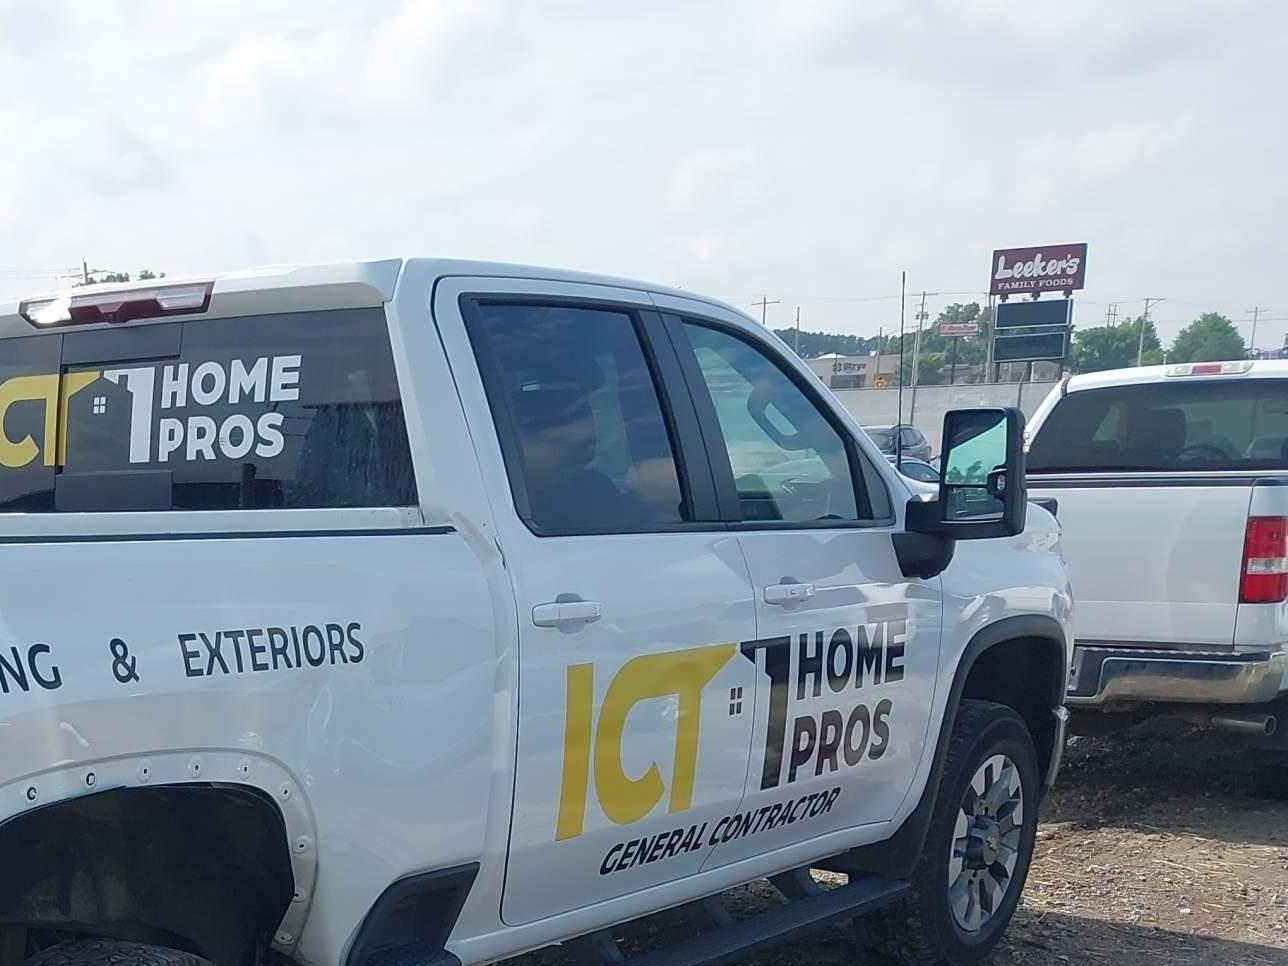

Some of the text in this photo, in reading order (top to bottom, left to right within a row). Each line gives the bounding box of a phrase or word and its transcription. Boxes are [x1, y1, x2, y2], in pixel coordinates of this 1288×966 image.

[994, 252, 1080, 279] Leeker's
[998, 277, 1074, 290] FAMILY FOODS
[160, 354, 303, 410] HOME
[158, 412, 286, 463] PROS
[109, 637, 140, 684] &
[177, 622, 365, 677] EXTERIORS
[796, 620, 907, 701] HOME
[787, 698, 894, 784] PROS
[599, 787, 842, 877] GENERAL CONTRACTOR
